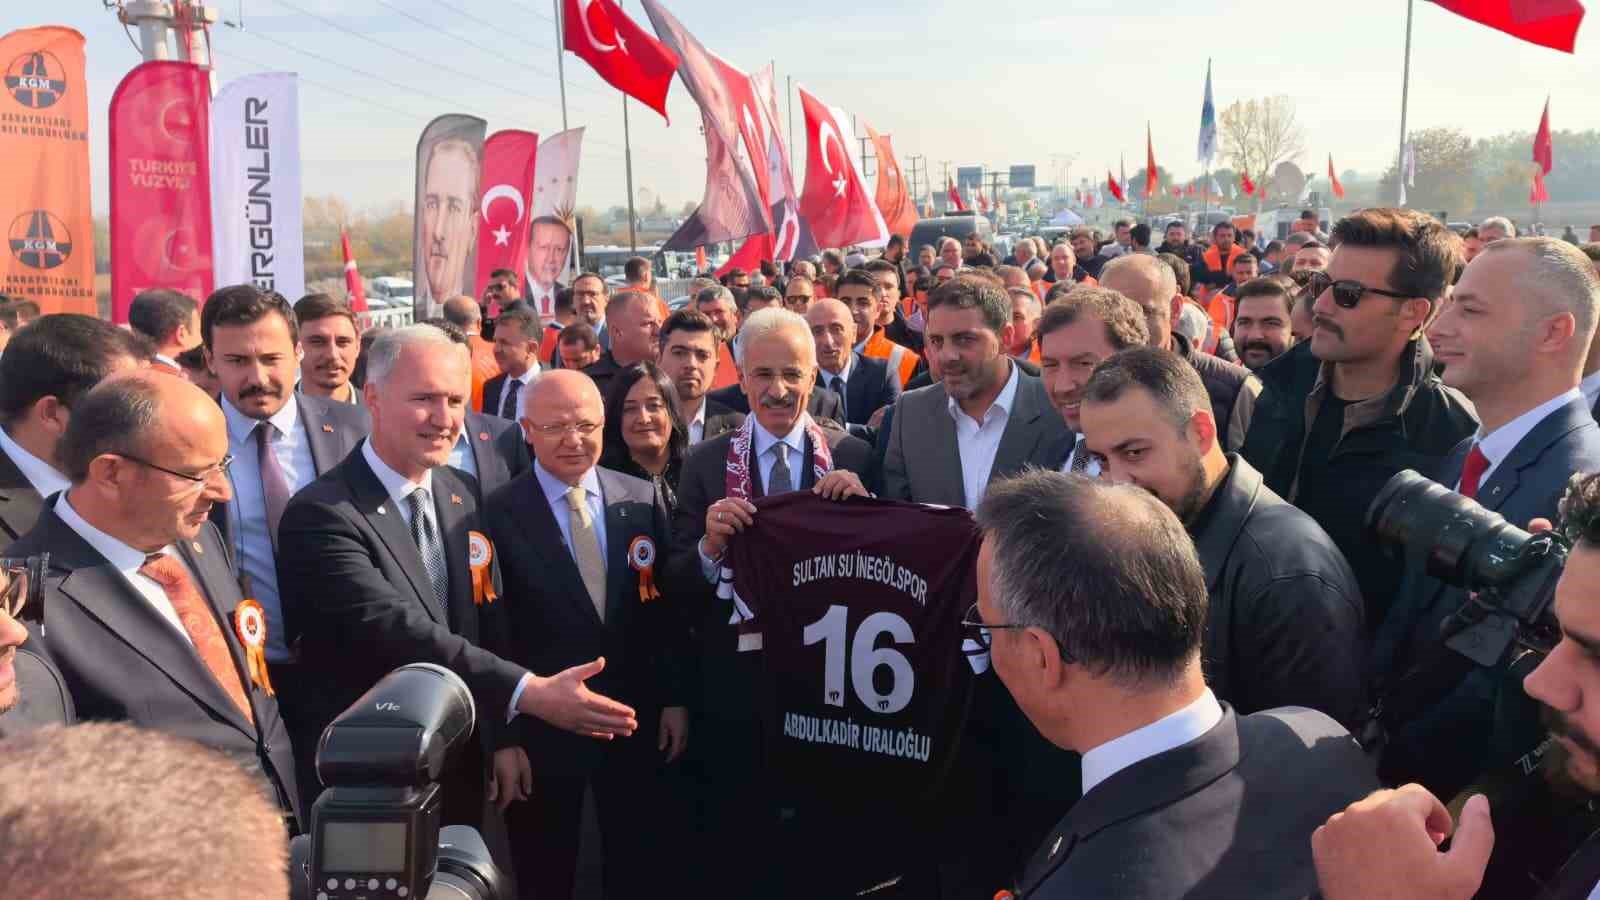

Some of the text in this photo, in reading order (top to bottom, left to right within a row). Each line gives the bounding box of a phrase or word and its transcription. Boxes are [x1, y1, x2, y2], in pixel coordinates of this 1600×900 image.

[19, 77, 50, 89] KGM
[24, 241, 57, 250] KGM
[793, 549, 928, 607] SULTAN SU İNEGÖLSPOR
[803, 604, 915, 714] 16
[784, 711, 931, 762] ABDULKADİR URALOĞLU
